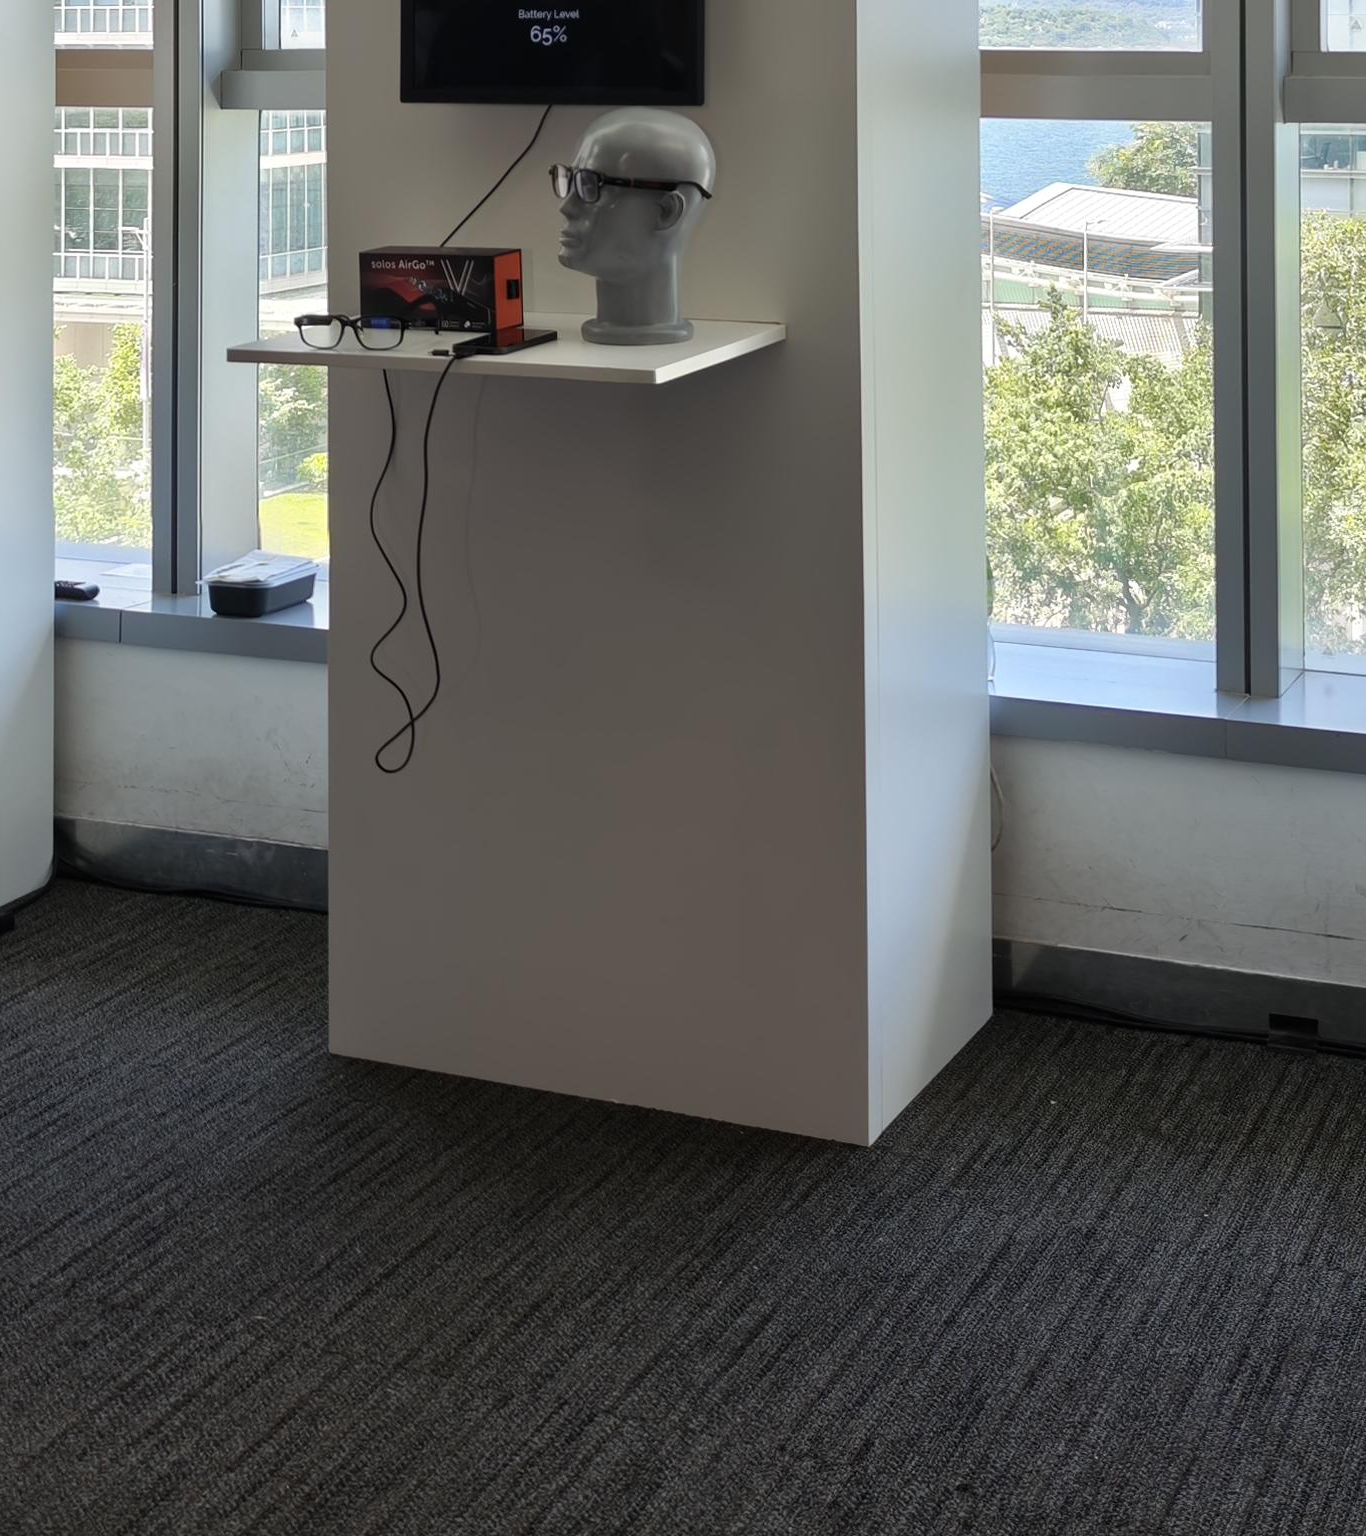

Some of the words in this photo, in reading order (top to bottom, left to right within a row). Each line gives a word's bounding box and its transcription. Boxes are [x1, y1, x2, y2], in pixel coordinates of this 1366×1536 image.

[518, 9, 552, 21] Battery
[554, 9, 579, 19] Level
[530, 25, 567, 45] 65%
[371, 260, 396, 269] solos
